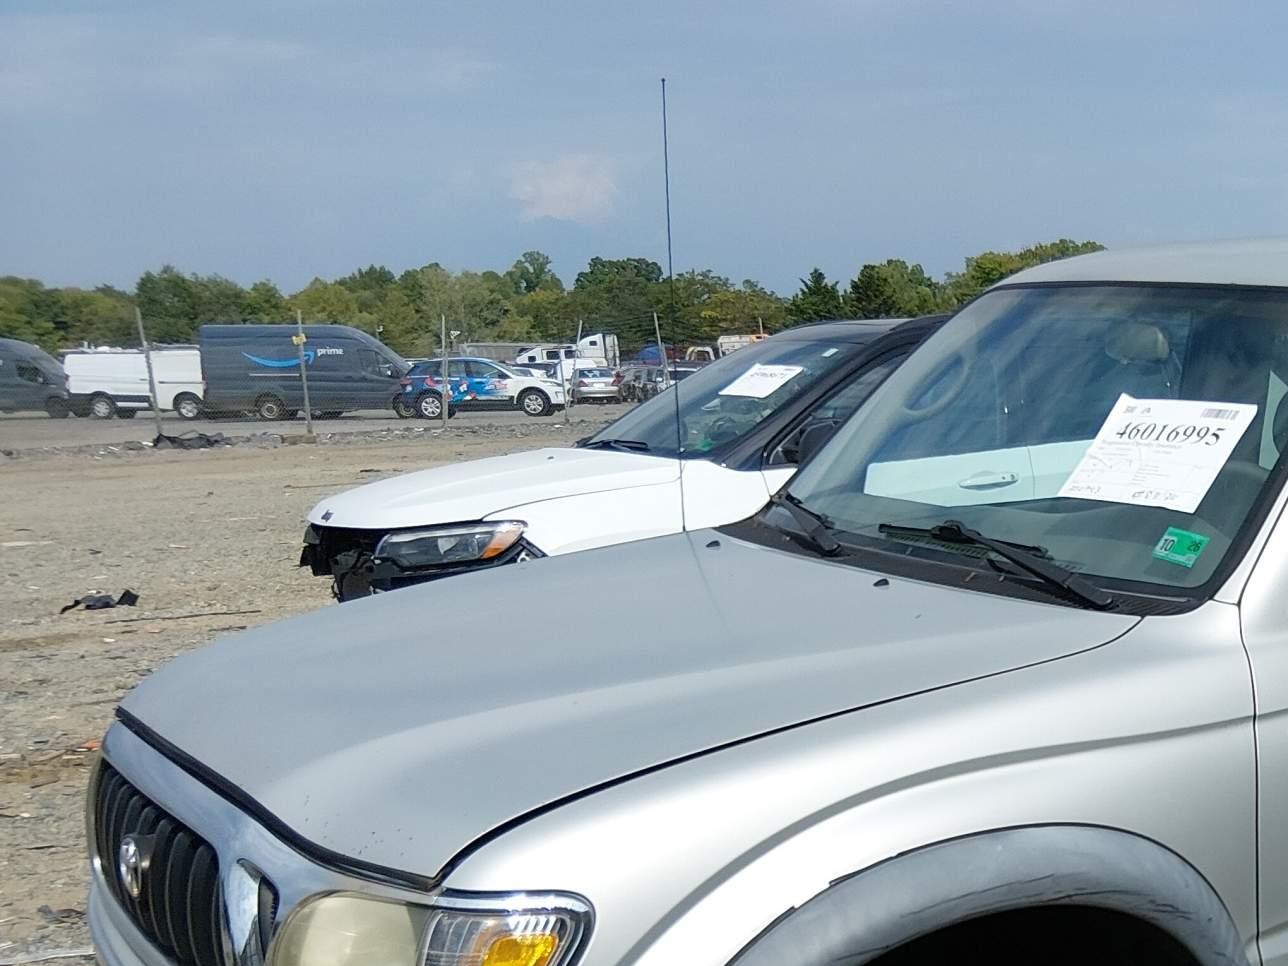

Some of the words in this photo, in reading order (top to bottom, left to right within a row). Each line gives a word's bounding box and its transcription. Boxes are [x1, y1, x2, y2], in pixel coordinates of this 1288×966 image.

[316, 347, 345, 357] prime
[1116, 421, 1226, 446] 46016995
[1159, 538, 1176, 552] 10
[1186, 540, 1202, 552] 26
